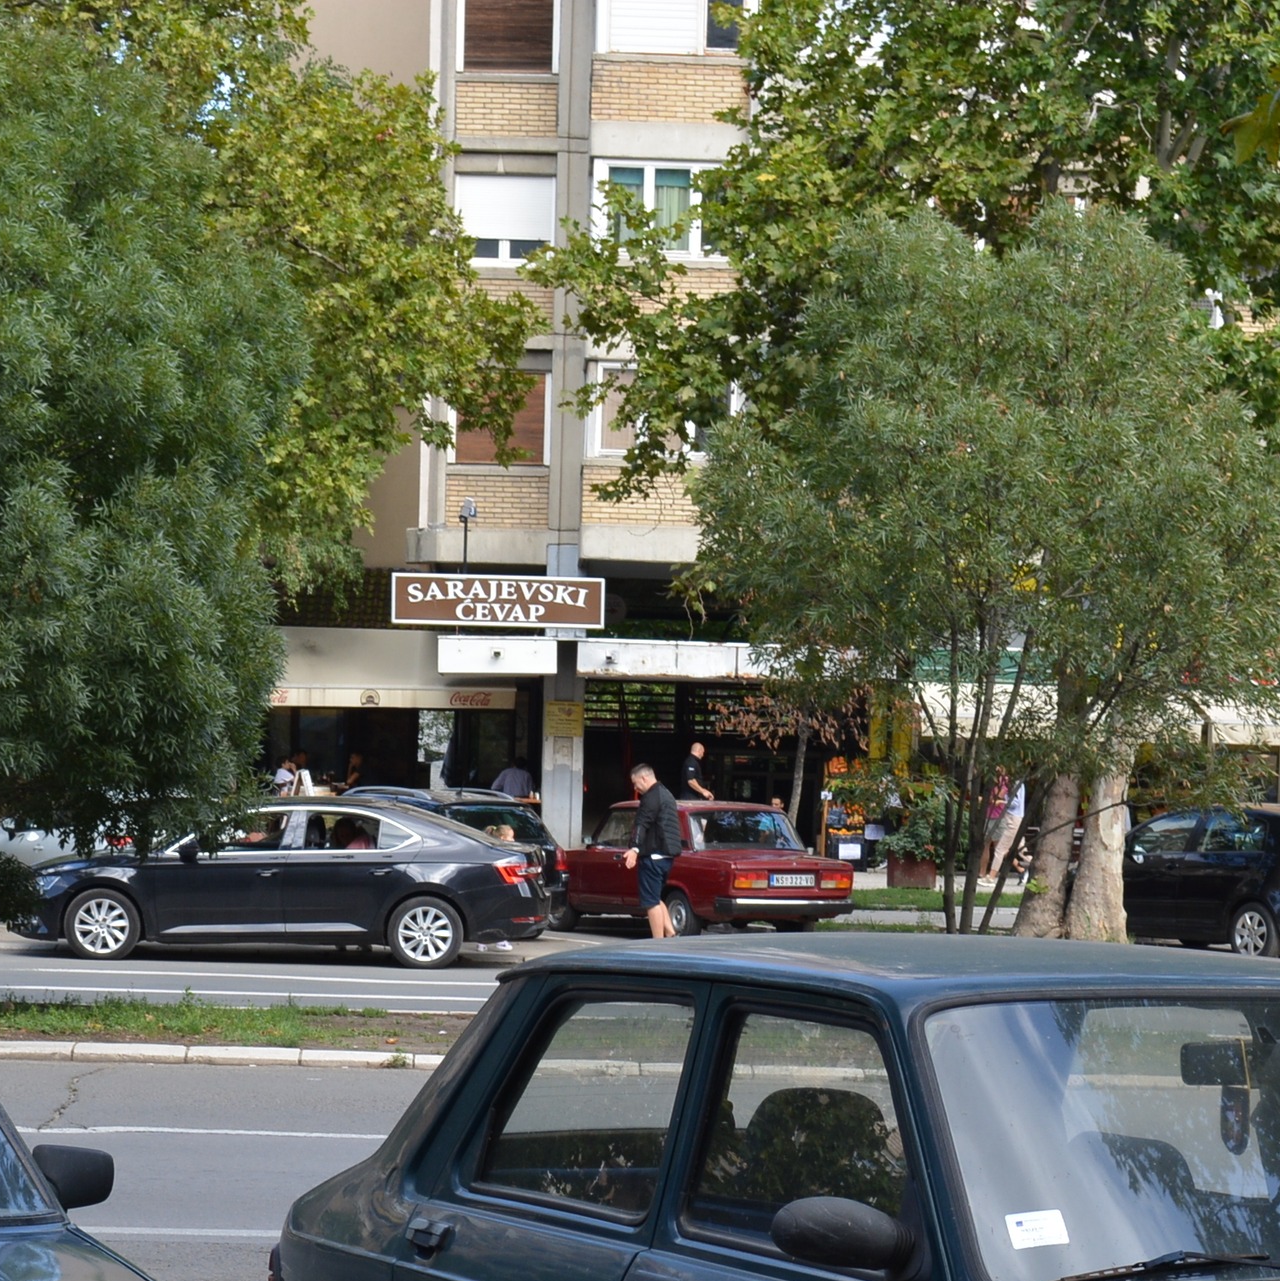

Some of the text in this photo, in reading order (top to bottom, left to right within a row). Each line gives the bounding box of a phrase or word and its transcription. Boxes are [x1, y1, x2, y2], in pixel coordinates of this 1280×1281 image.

[407, 580, 589, 608] SARAJEVSKI
[455, 598, 546, 622] ĆEVAP
[775, 876, 785, 885] NS
